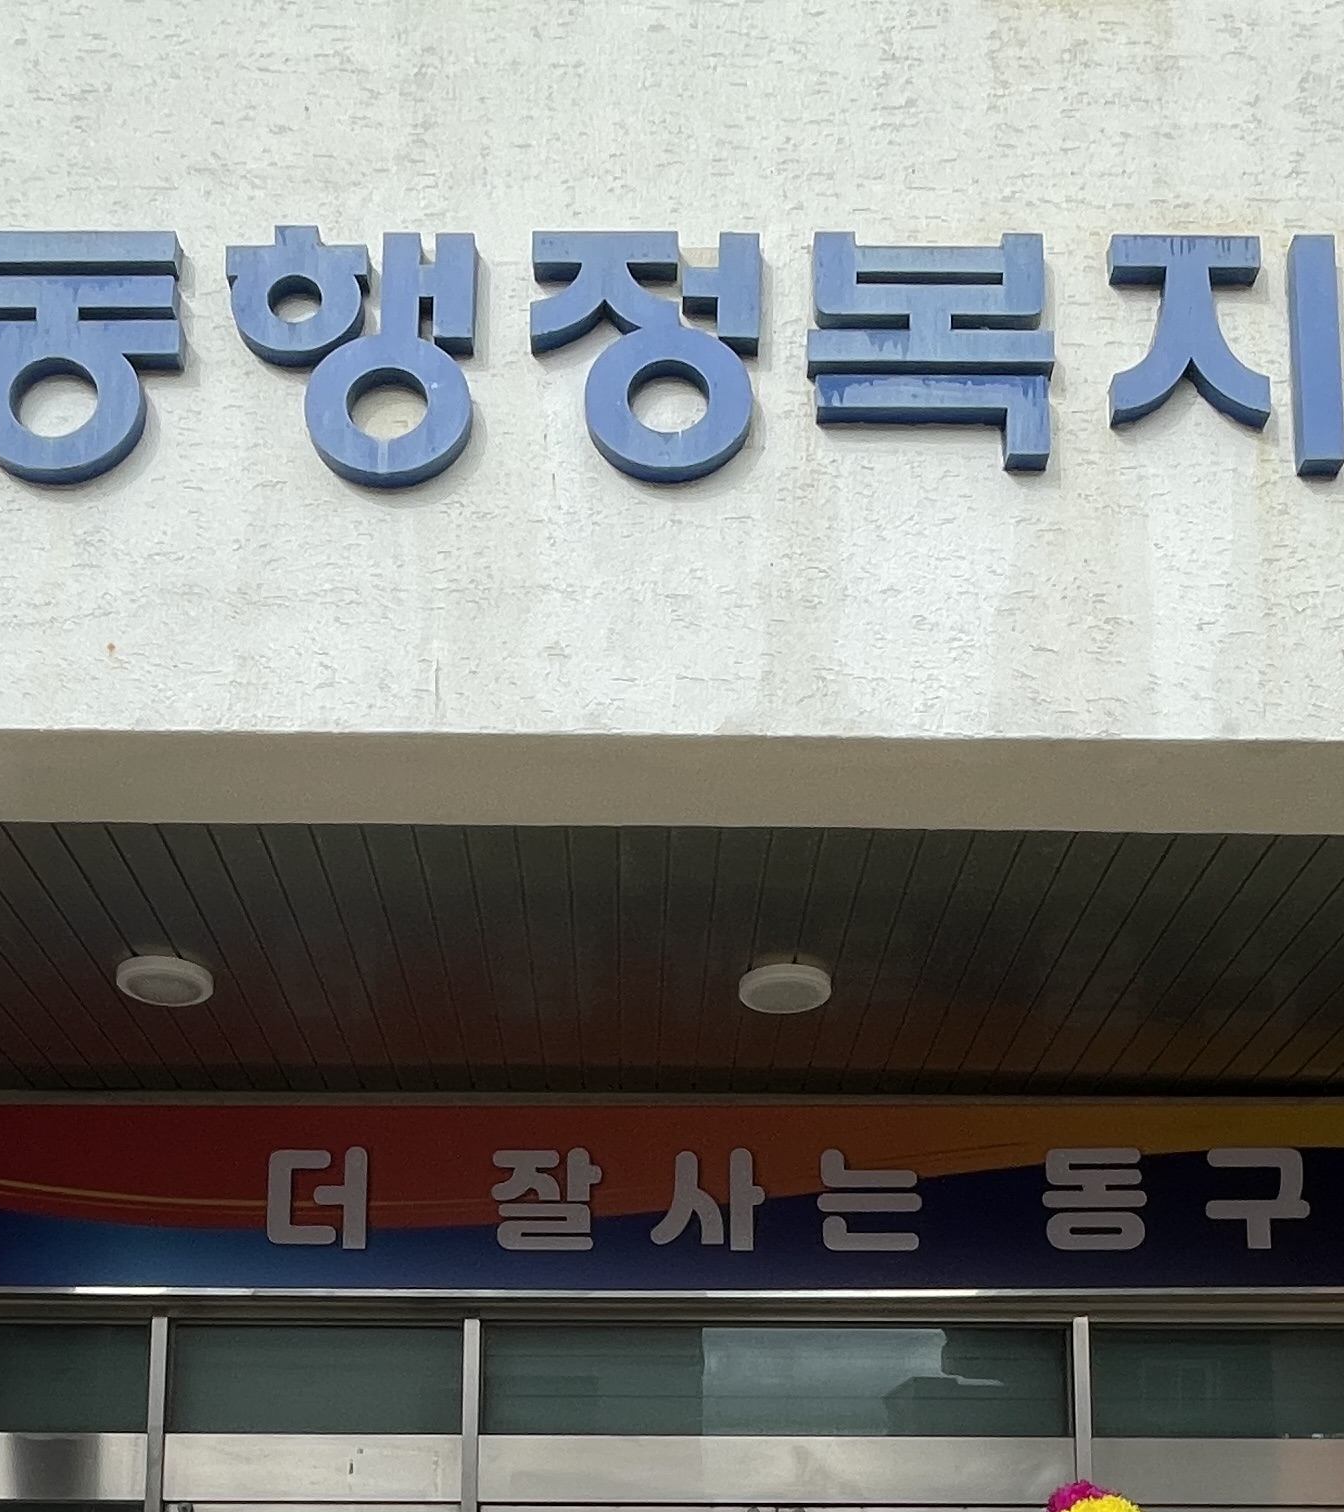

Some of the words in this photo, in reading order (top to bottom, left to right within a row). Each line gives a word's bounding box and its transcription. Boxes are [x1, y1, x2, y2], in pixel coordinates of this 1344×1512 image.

[267, 1146, 368, 1250] 더
[491, 1147, 923, 1251] 잘사는
[1042, 1148, 1311, 1251] 동구
